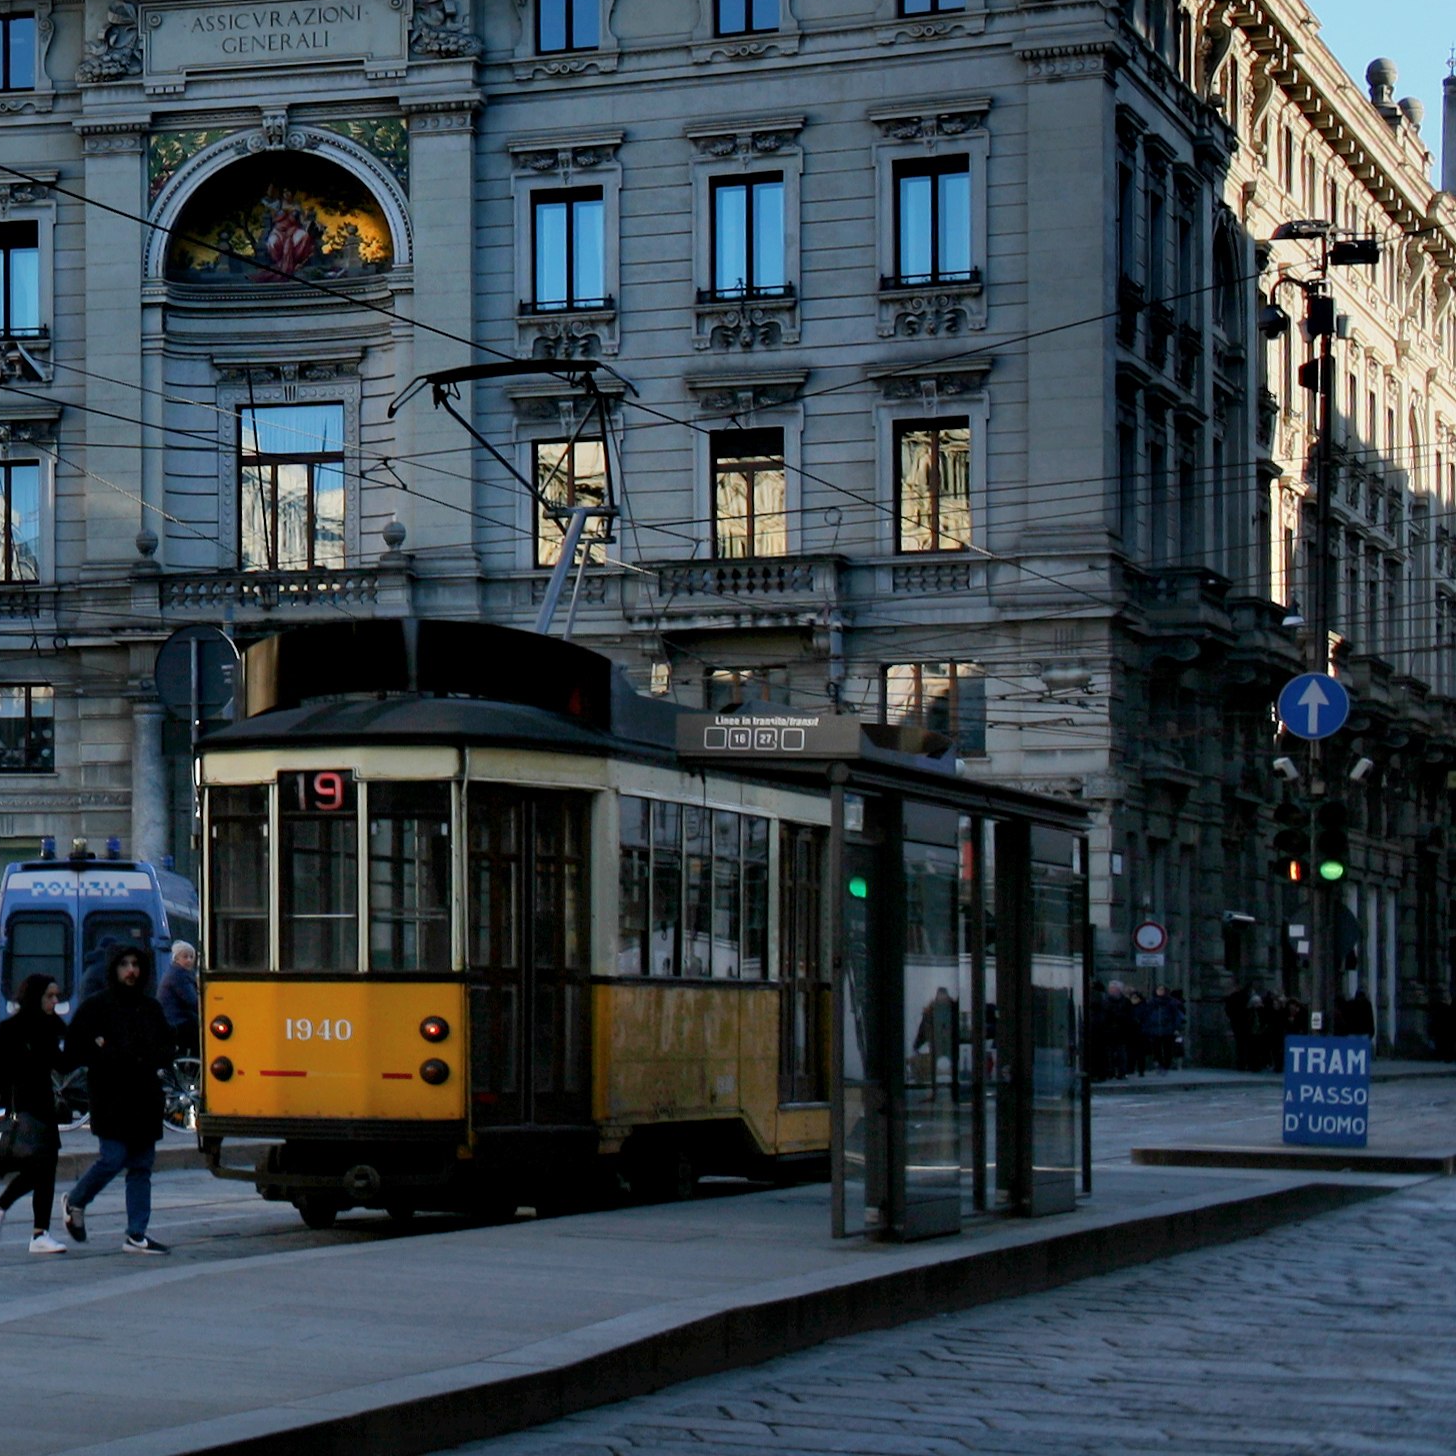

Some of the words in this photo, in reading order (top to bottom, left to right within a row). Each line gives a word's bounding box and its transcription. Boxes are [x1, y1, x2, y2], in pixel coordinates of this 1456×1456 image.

[221, 30, 329, 54] GENERALI
[759, 733, 772, 744] 27
[296, 771, 343, 811] 19
[31, 881, 129, 897] POLIZIA
[286, 1018, 352, 1040] 1940
[1288, 1046, 1367, 1075] TRAM
[1300, 1084, 1368, 1105] PASSO
